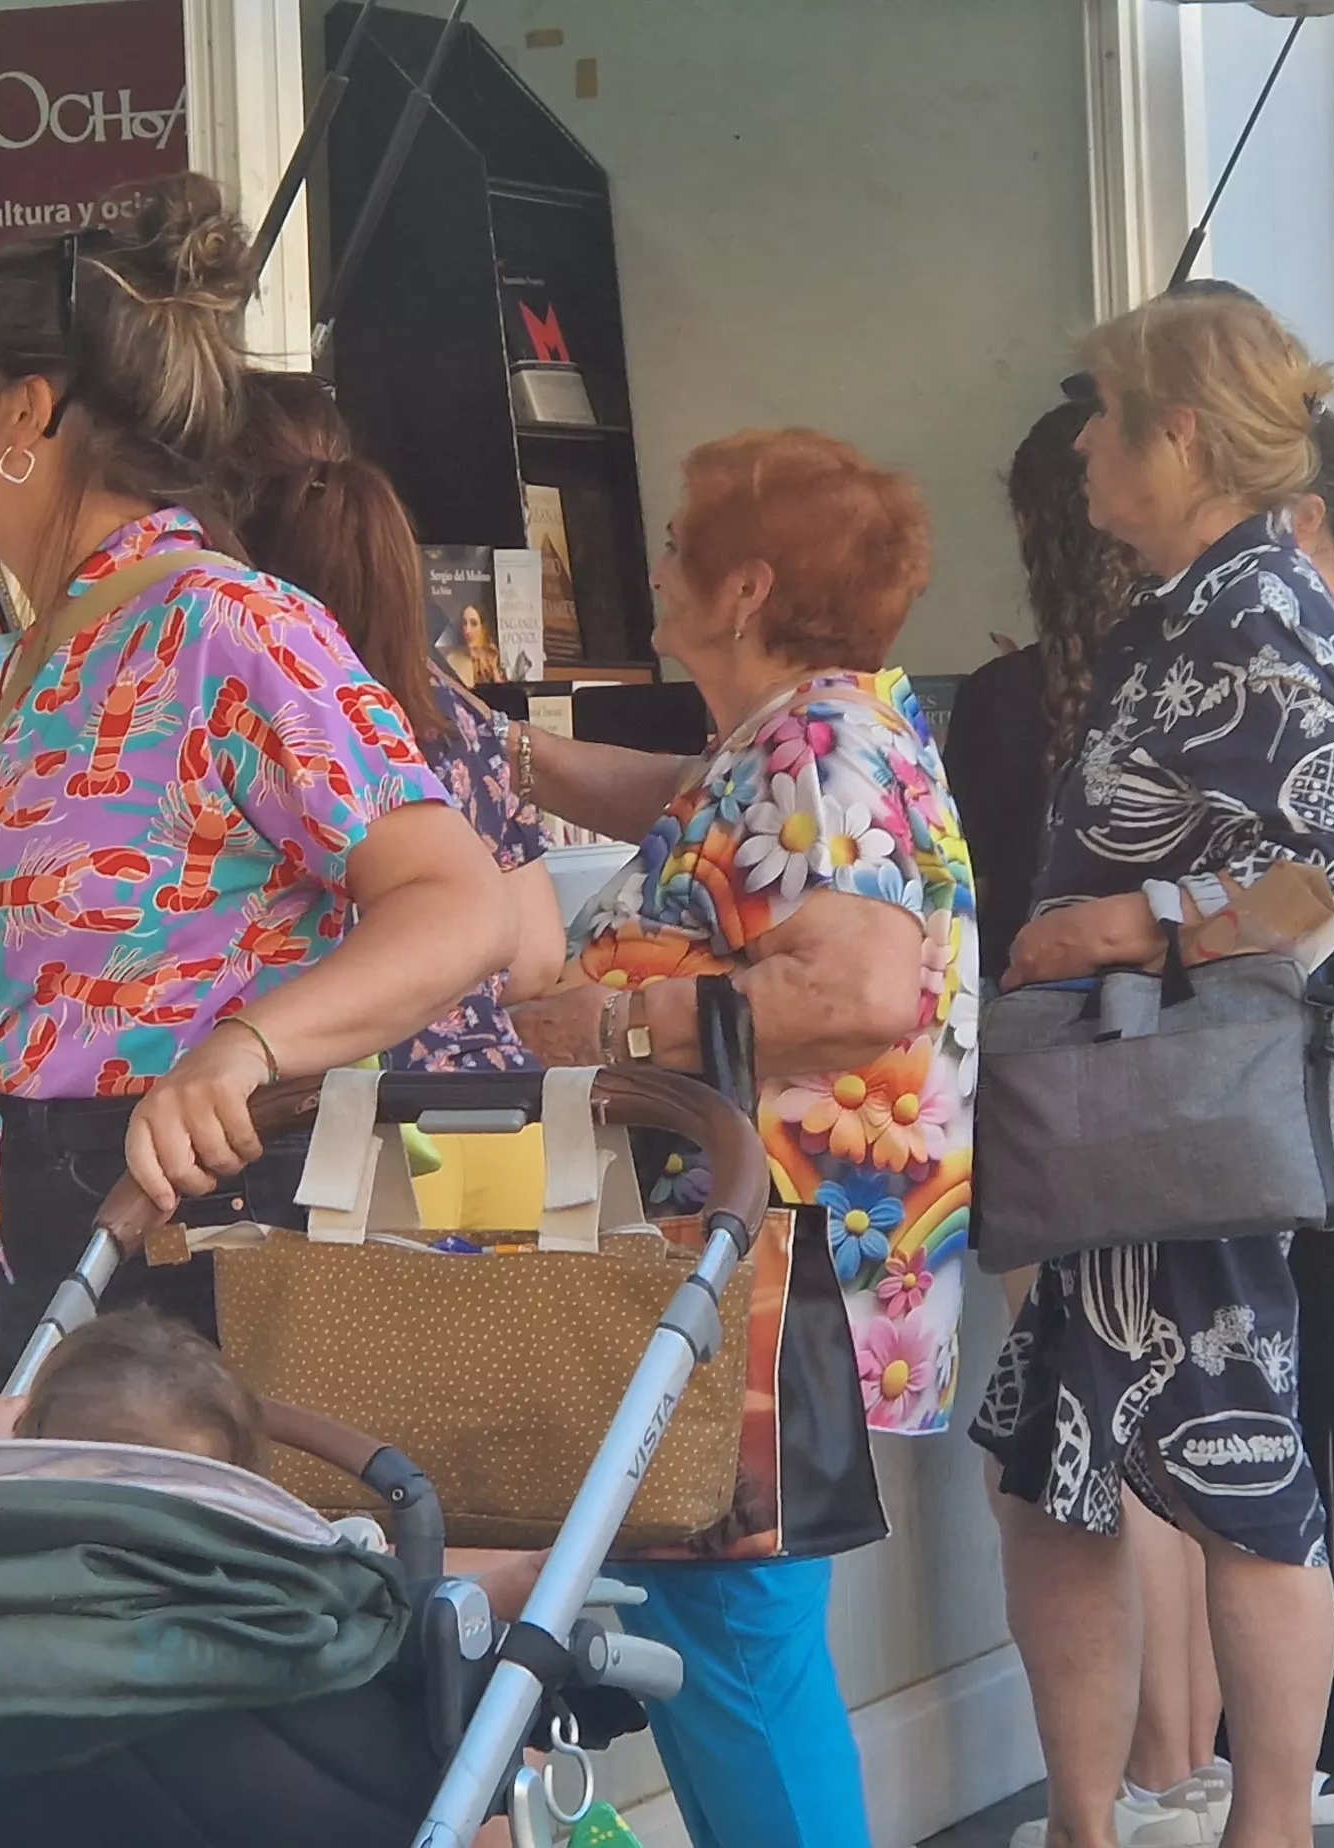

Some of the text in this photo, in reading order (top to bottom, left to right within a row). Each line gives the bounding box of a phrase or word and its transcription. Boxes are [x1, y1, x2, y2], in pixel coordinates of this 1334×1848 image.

[78, 202, 95, 228] y
[101, 191, 154, 219] oci
[627, 1392, 676, 1480] VISTA
